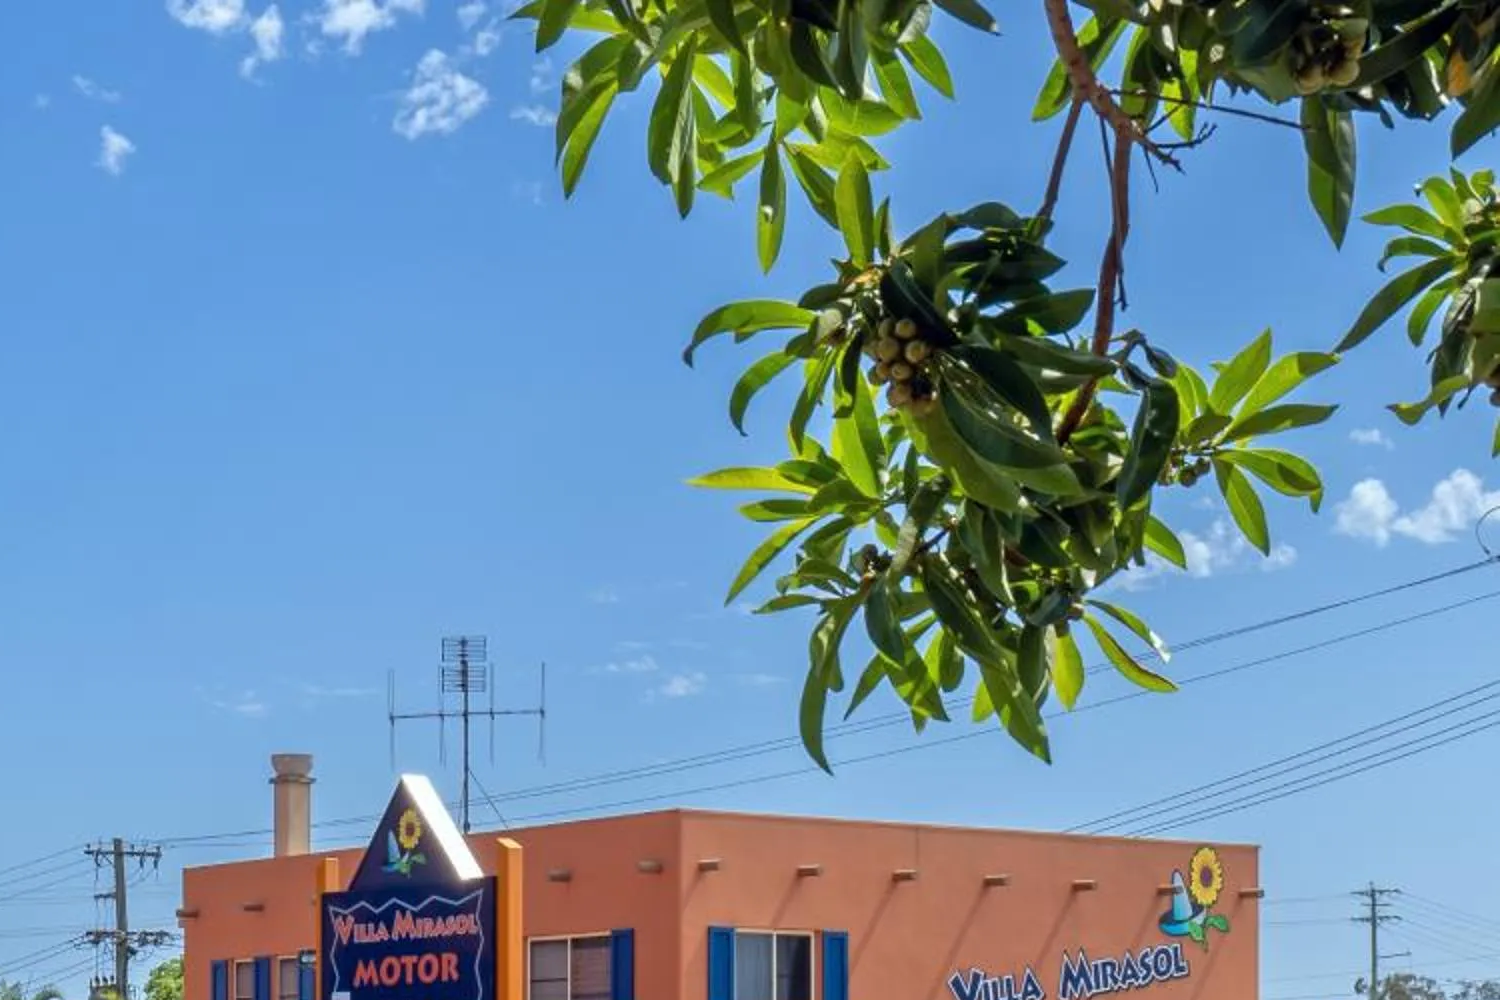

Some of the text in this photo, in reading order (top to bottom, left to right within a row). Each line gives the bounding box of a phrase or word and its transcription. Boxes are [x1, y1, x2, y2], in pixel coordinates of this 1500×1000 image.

[335, 910, 479, 945] VILLA MIRASOL
[352, 952, 460, 988] MOTOR
